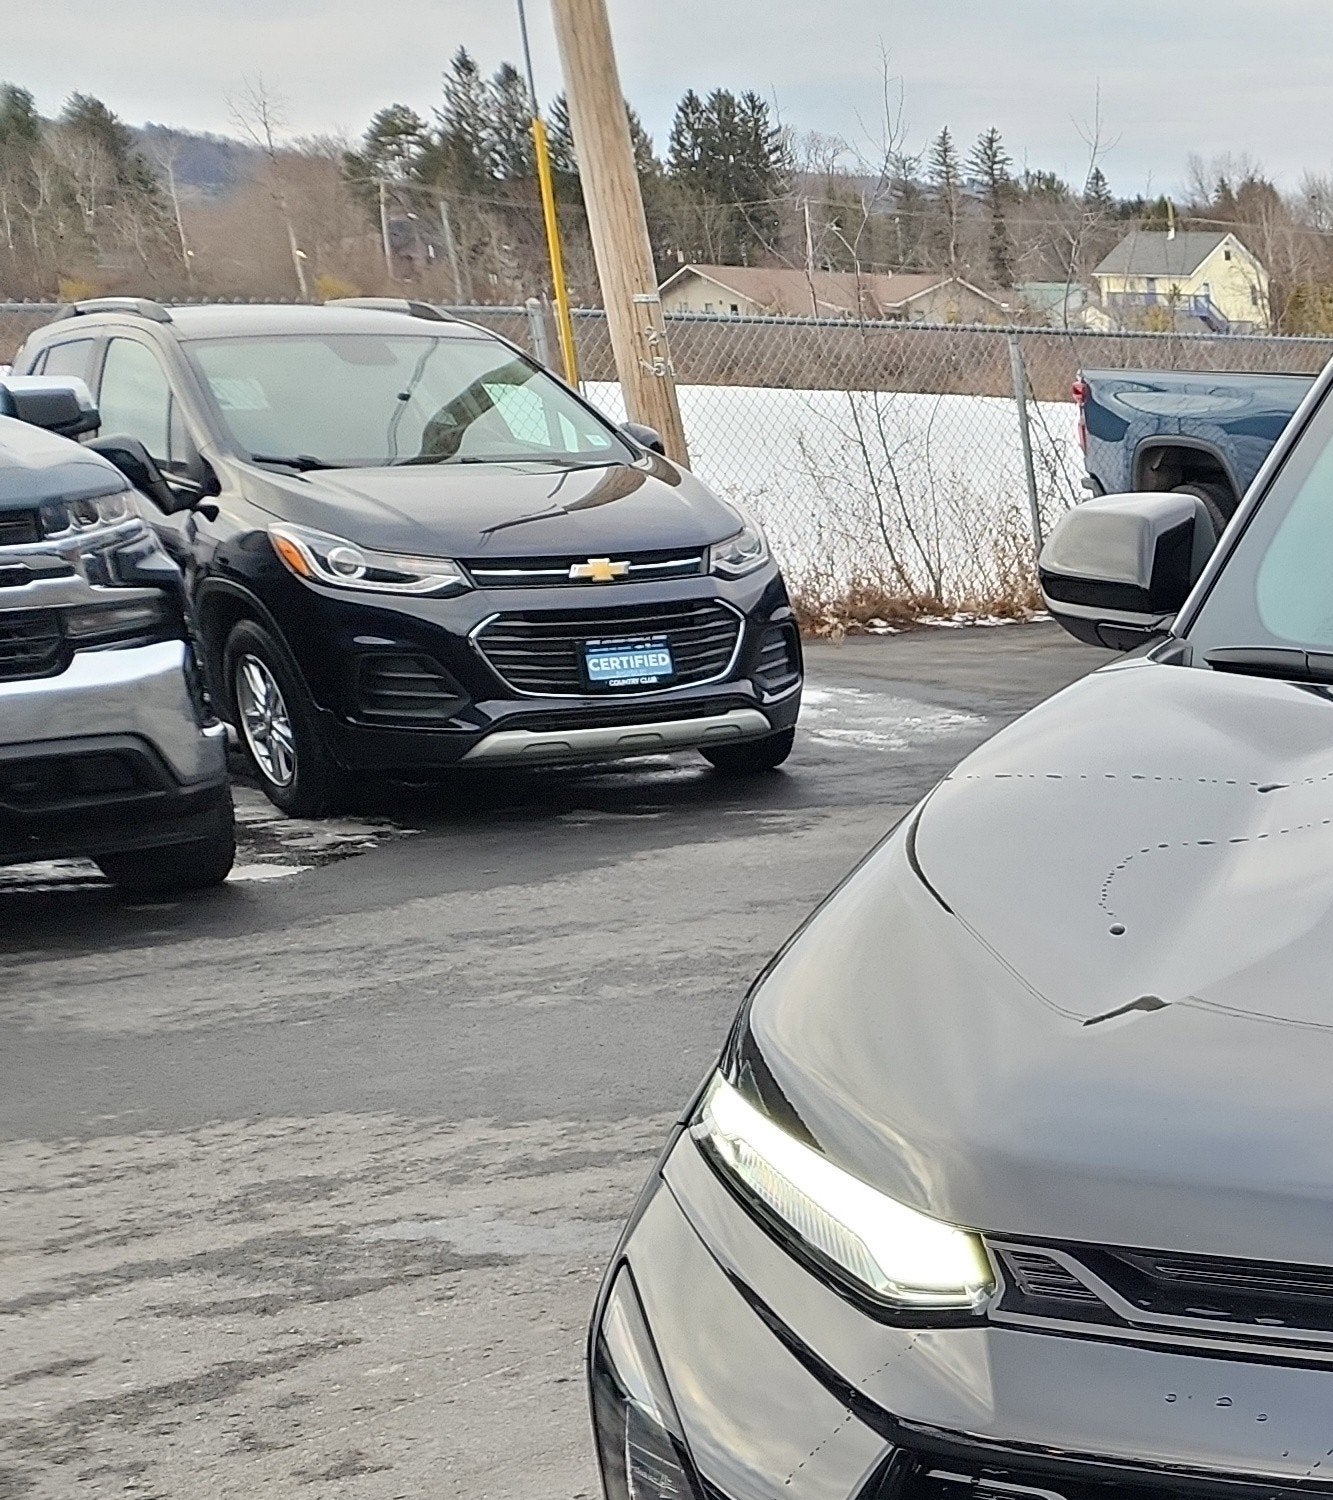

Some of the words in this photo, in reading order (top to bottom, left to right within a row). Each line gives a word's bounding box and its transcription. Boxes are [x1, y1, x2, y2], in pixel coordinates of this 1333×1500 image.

[588, 653, 671, 671] CERTIFIED
[608, 677, 639, 686] COUNTRY
[639, 675, 658, 685] CLUB
